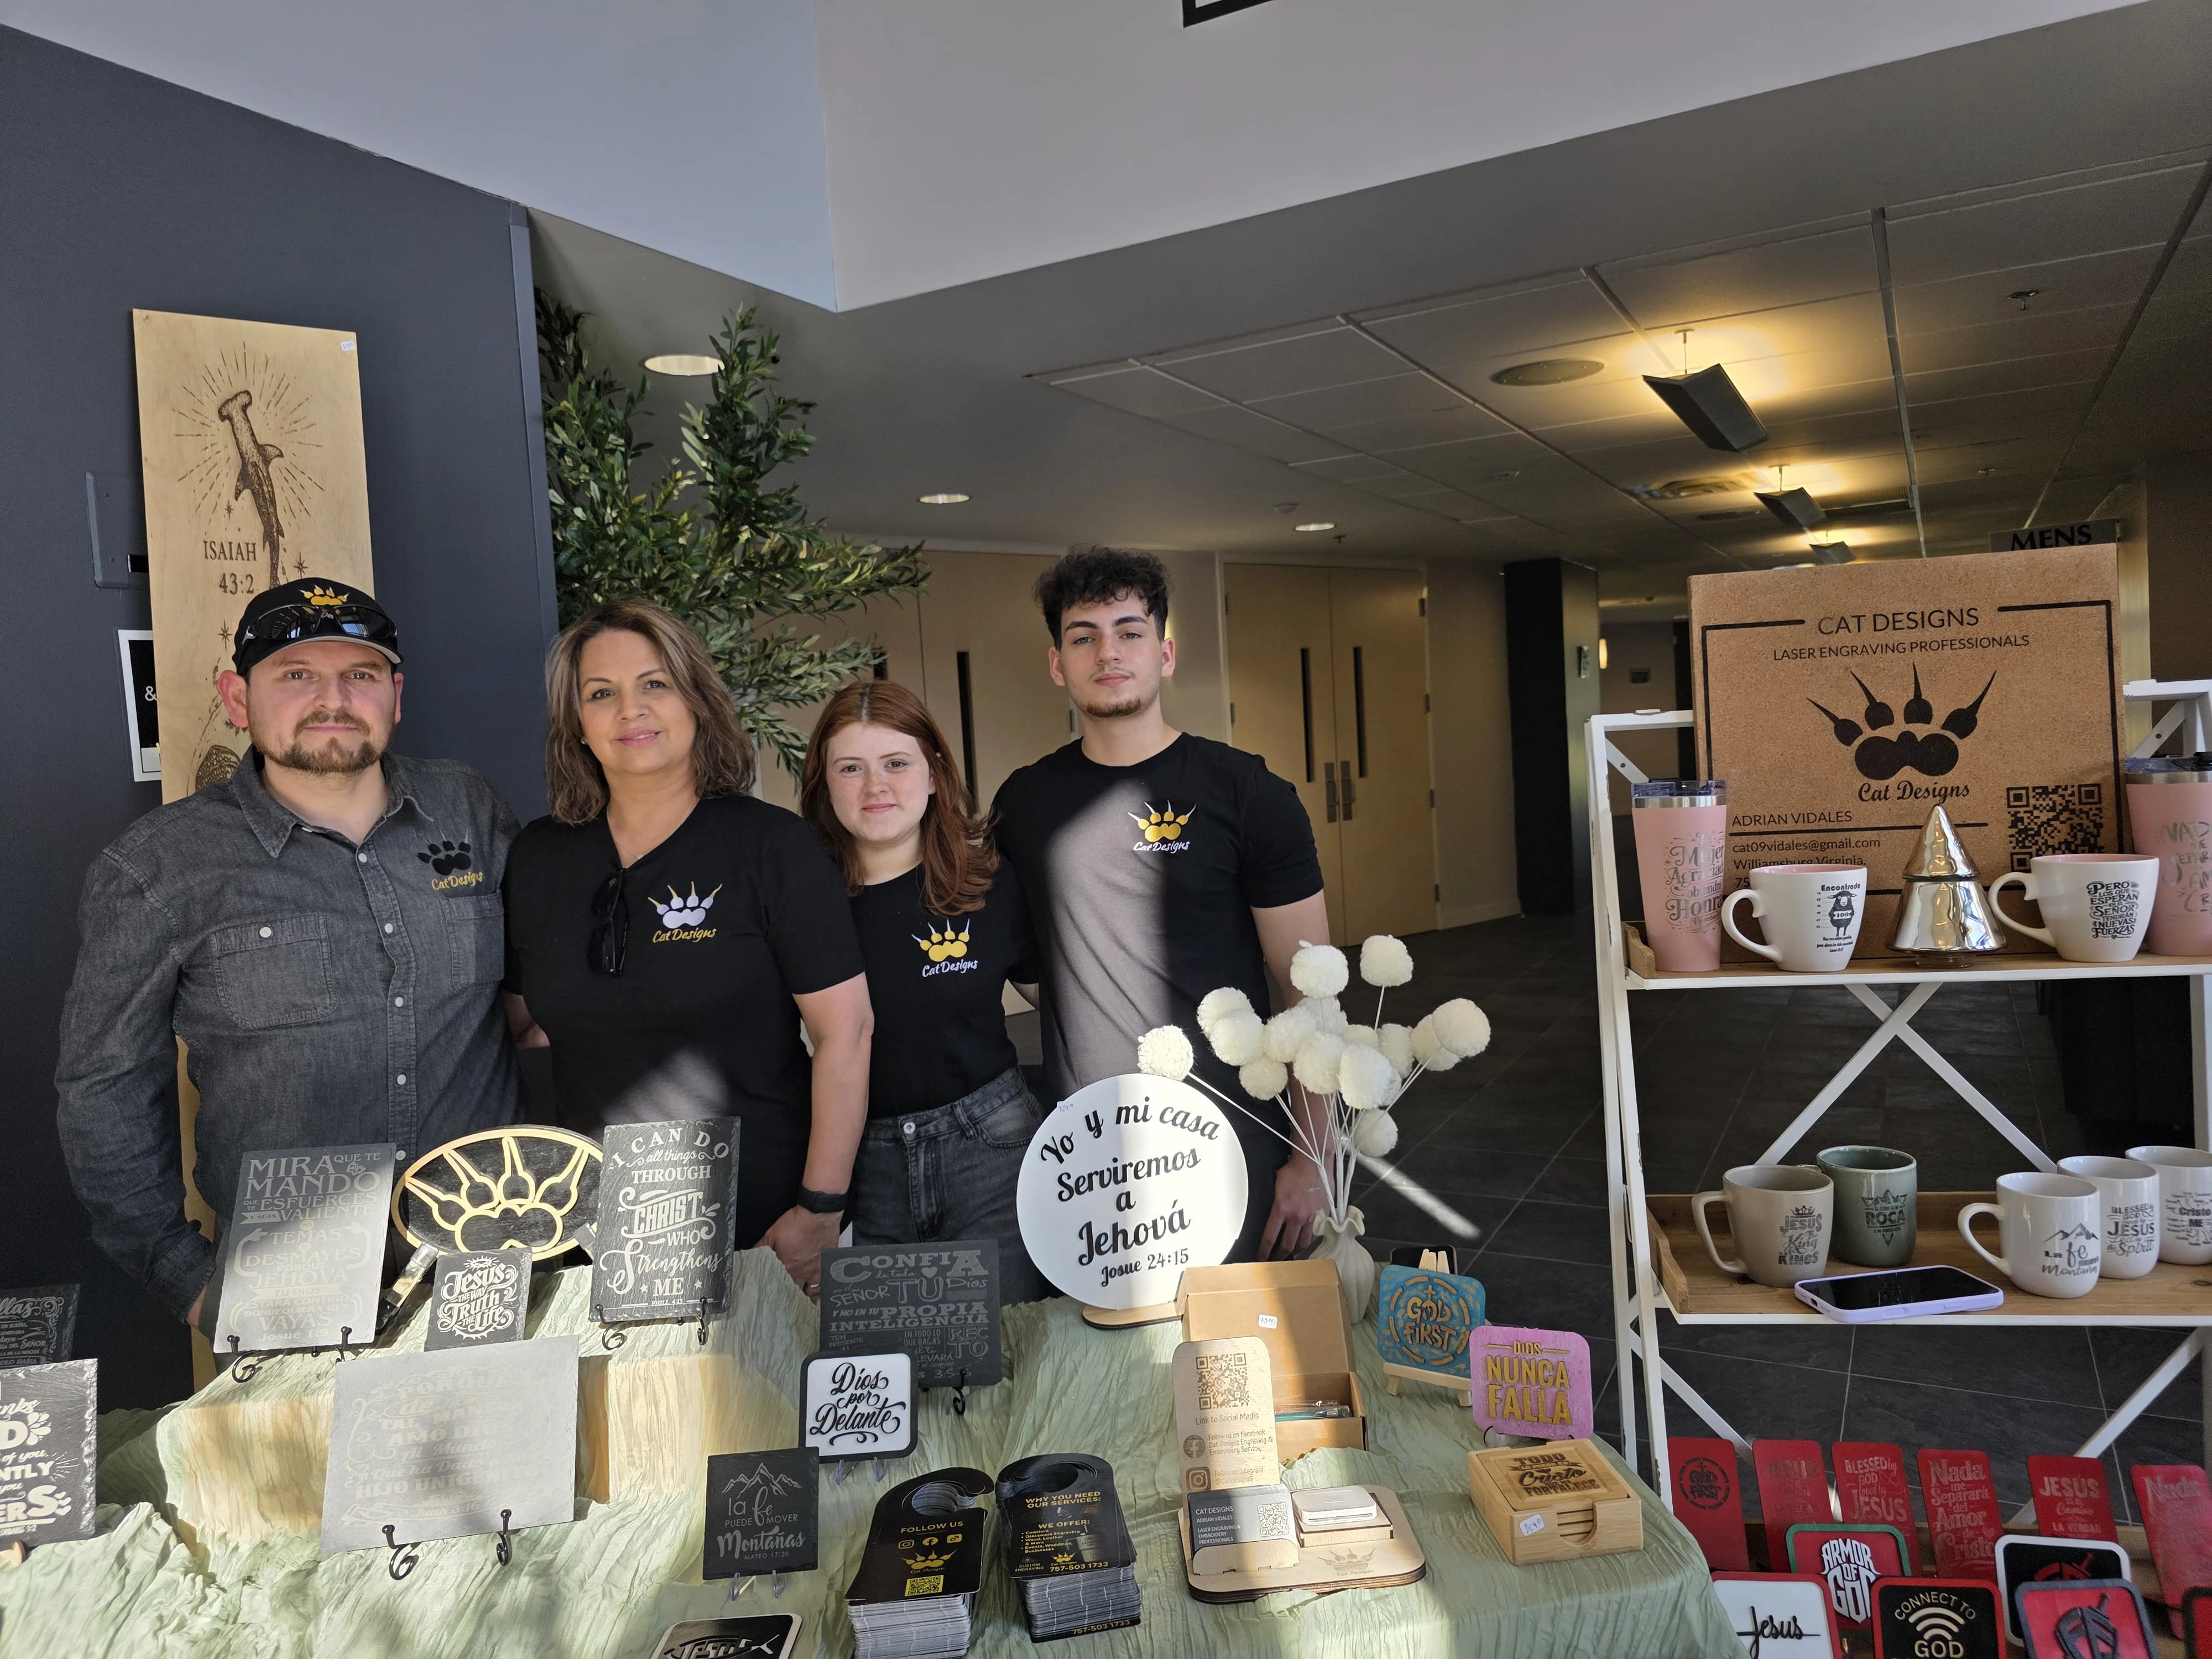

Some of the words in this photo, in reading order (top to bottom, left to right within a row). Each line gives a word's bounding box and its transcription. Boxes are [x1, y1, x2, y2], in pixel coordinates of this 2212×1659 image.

[2011, 525, 2092, 551] MENS
[203, 540, 257, 561] ISAIAH
[219, 572, 255, 596] 43:2
[1818, 614, 1867, 635] CAT
[1873, 608, 1980, 633] DESIGNS
[1773, 647, 1817, 661] LASER
[1820, 641, 1906, 658] ENGRAVING
[1911, 634, 2030, 654] PROFESSIONALS
[1858, 782, 1890, 802] Cat
[1897, 780, 1970, 806] Designs
[1731, 813, 1788, 827] ADRIAN
[1791, 811, 1853, 825] VIDALES
[1133, 841, 1152, 852] Cat
[1153, 841, 1190, 854] Designs
[1733, 838, 1881, 854] cat09vidales@gmail.com
[1821, 883, 1860, 891] Encontrado
[2090, 893, 2138, 905] ESPERAN
[2099, 917, 2133, 928] NUEVAS
[653, 930, 672, 943] Cat
[672, 926, 717, 943] Designs
[922, 964, 940, 978] Cat
[941, 959, 978, 976] Designs
[1040, 1131, 1074, 1165] Yo
[1084, 1110, 1104, 1139] y
[1116, 1096, 1152, 1125] mi
[1159, 1107, 1220, 1140] casa
[612, 1152, 625, 1168] I
[631, 1128, 683, 1154] CAN
[694, 1131, 729, 1159] DO
[646, 1151, 665, 1163] all
[665, 1150, 698, 1164] things
[249, 1155, 336, 1180] MIRA
[334, 1154, 361, 1163] QUE
[632, 1165, 712, 1184] THROUGH
[1057, 1147, 1202, 1202] Serviremos
[246, 1171, 380, 1199] MANDO
[260, 1192, 378, 1211] ESFUERCES
[1116, 1190, 1136, 1212] a
[634, 1191, 704, 1234] CHRIST
[1865, 1209, 1906, 1225] ROCA
[2179, 1207, 2211, 1216] Cristo
[1078, 1199, 1191, 1266] Jehová
[1780, 1213, 1822, 1233] JESUS
[2107, 1222, 2154, 1237] JESUS
[2189, 1219, 2203, 1227] ME
[270, 1228, 342, 1244] TEMAS
[667, 1230, 700, 1246] WHO
[246, 1248, 359, 1267] DESMAYES
[2066, 1241, 2089, 1268] fe
[276, 1262, 327, 1272] PORQUE
[600, 1239, 723, 1295] Strengthens
[831, 1250, 989, 1283] CONFIA
[1101, 1260, 1142, 1287] Josue
[1147, 1248, 1190, 1271] 24:15
[293, 1287, 321, 1296] DIOS
[458, 1293, 471, 1302] THE
[471, 1286, 488, 1300] WAY
[653, 1277, 684, 1297] ME
[830, 1286, 890, 1307] SEÑOR
[886, 1277, 943, 1304] TU
[946, 1278, 988, 1288] Dios
[296, 1295, 349, 1306] CONTIGO
[881, 1302, 988, 1319] PROPIA
[260, 1313, 332, 1332] VAYAS
[830, 1314, 990, 1332] INTELIGENCIA
[259, 1332, 301, 1343] Josué
[309, 1329, 330, 1338] 1:9
[1405, 1321, 1457, 1351] FIRST
[831, 1362, 889, 1396] Dios
[1486, 1355, 1571, 1389] NUNCA
[837, 1390, 880, 1409] por
[1488, 1384, 1572, 1426] FALLA
[810, 1397, 906, 1436] Delante
[1196, 1417, 1209, 1425] Link
[1219, 1413, 1238, 1422] Social
[1240, 1411, 1259, 1420] Media
[1219, 1439, 1240, 1448] Designs
[1240, 1436, 1266, 1446] Engraving
[1513, 1452, 1566, 1465] TODO
[1844, 1456, 1887, 1474] BLESSED
[1519, 1467, 1587, 1486] Cristo
[1859, 1473, 1879, 1486] GOD
[1927, 1458, 1987, 1487] Nada
[1950, 1482, 1966, 1491] me
[729, 1498, 746, 1516] la
[752, 1486, 773, 1526] fe
[1051, 1496, 1102, 1506] SERVICES:
[1208, 1505, 1234, 1514] DESIGNS
[1849, 1489, 1908, 1522] JESUS
[1952, 1501, 1969, 1513] del
[725, 1517, 753, 1528] PUEDE
[766, 1514, 798, 1524] MOVER
[900, 1522, 946, 1534] FOLLOW
[1211, 1524, 1237, 1532] ENGRAVING
[1933, 1506, 1987, 1533] Amor
[2052, 1521, 2065, 1532] LA
[2067, 1522, 2102, 1533] VERDAD
[717, 1526, 806, 1559] Montañas
[1199, 1536, 1234, 1545] PROFESSIONALS
[1963, 1528, 1975, 1539] de
[1820, 1538, 1882, 1575] ARMOR
[1050, 1564, 1086, 1572] 757-503
[1841, 1563, 1858, 1582] OF
[1894, 1591, 1959, 1621] CONNECT
[1959, 1600, 1977, 1620] TO
[1073, 1624, 1108, 1635] 757-503
[1111, 1619, 1131, 1627] 1733
[1749, 1605, 1804, 1659] Jesus
[1914, 1640, 1964, 1658] GOD
